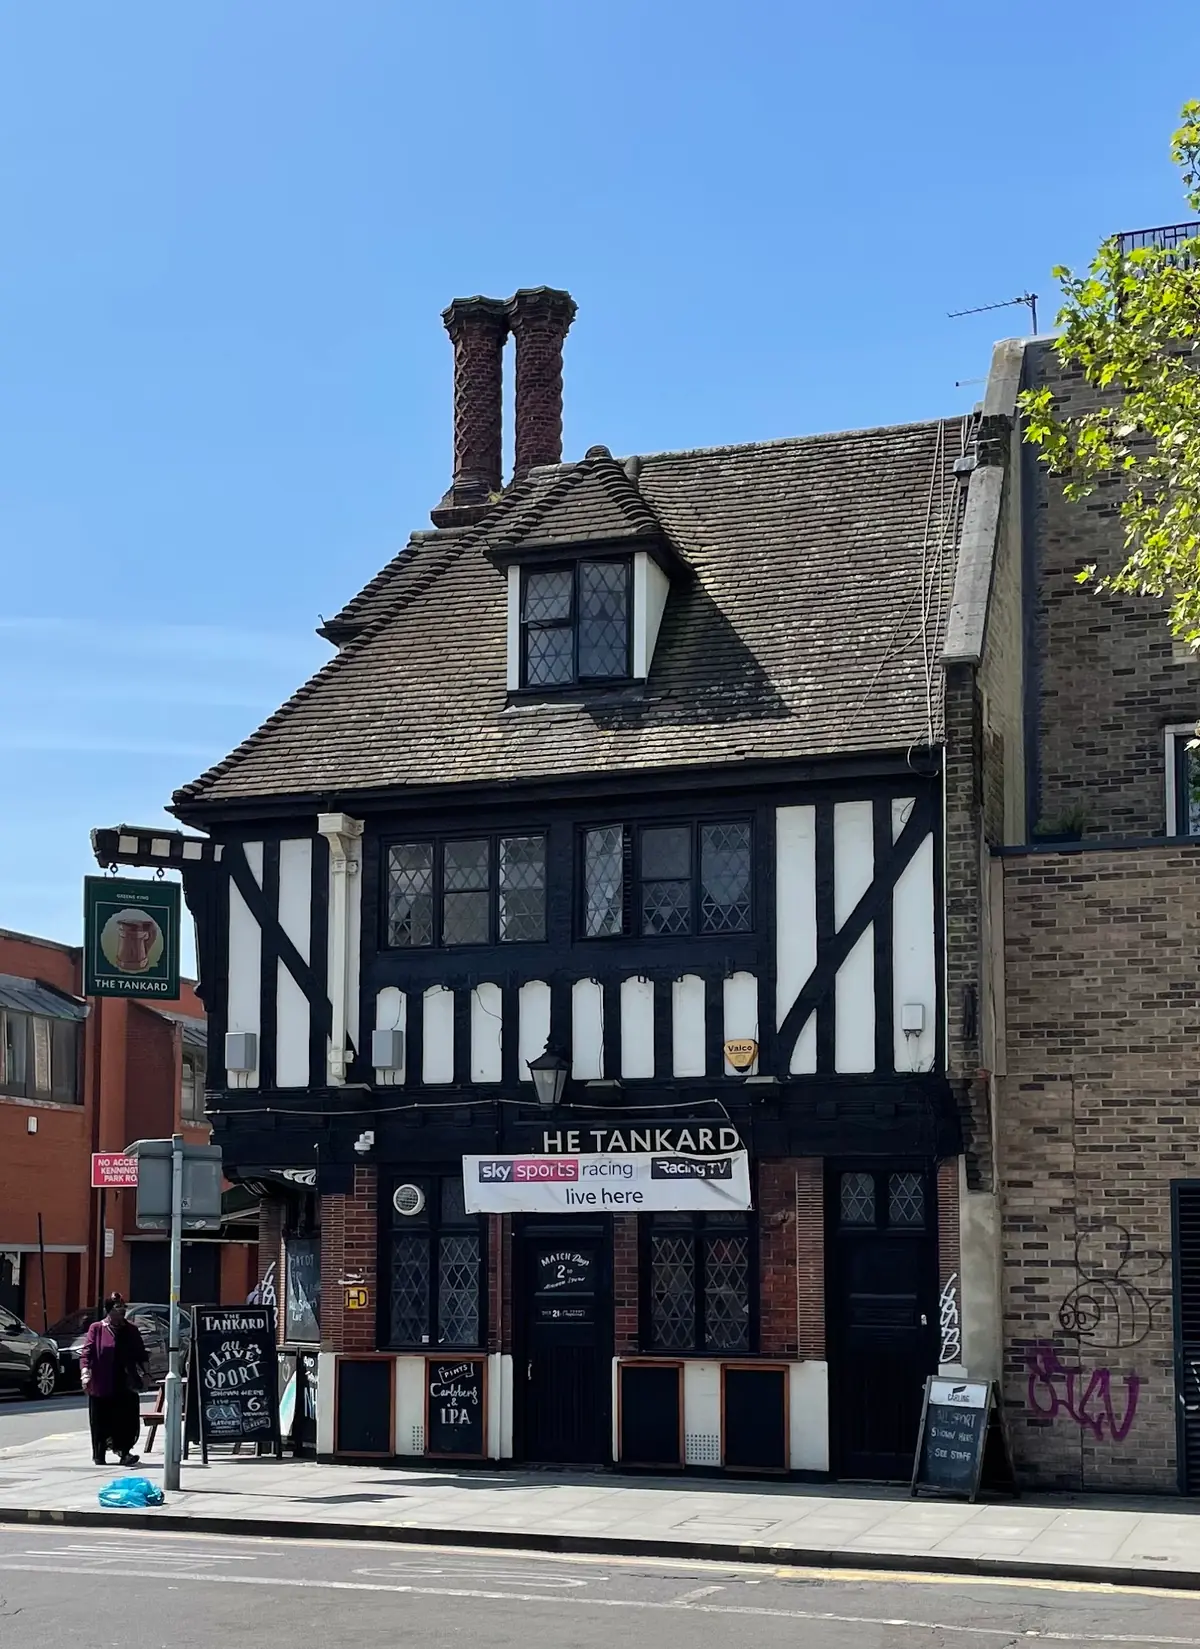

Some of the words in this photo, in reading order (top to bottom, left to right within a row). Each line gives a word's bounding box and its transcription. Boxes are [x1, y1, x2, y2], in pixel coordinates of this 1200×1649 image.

[95, 980, 115, 989] THE
[118, 981, 168, 992] TANKARD
[728, 1044, 752, 1052] Valco
[590, 1128, 740, 1152] TANKARD
[98, 1159, 110, 1167] NO
[482, 1161, 511, 1181] sky
[516, 1161, 576, 1180] sports
[582, 1161, 633, 1179] racing
[656, 1160, 706, 1177] Racing
[706, 1161, 728, 1175] TV
[565, 1188, 597, 1205] live
[602, 1187, 644, 1205] here
[541, 1252, 571, 1267] MATCH
[202, 1316, 265, 1331] TANKARD
[209, 1349, 255, 1367] LIVE
[205, 1360, 261, 1389] SPORT
[430, 1382, 478, 1406] Carlsberg
[247, 1396, 261, 1412] 6
[440, 1407, 472, 1425] IPA
[934, 1447, 948, 1458] SEE
